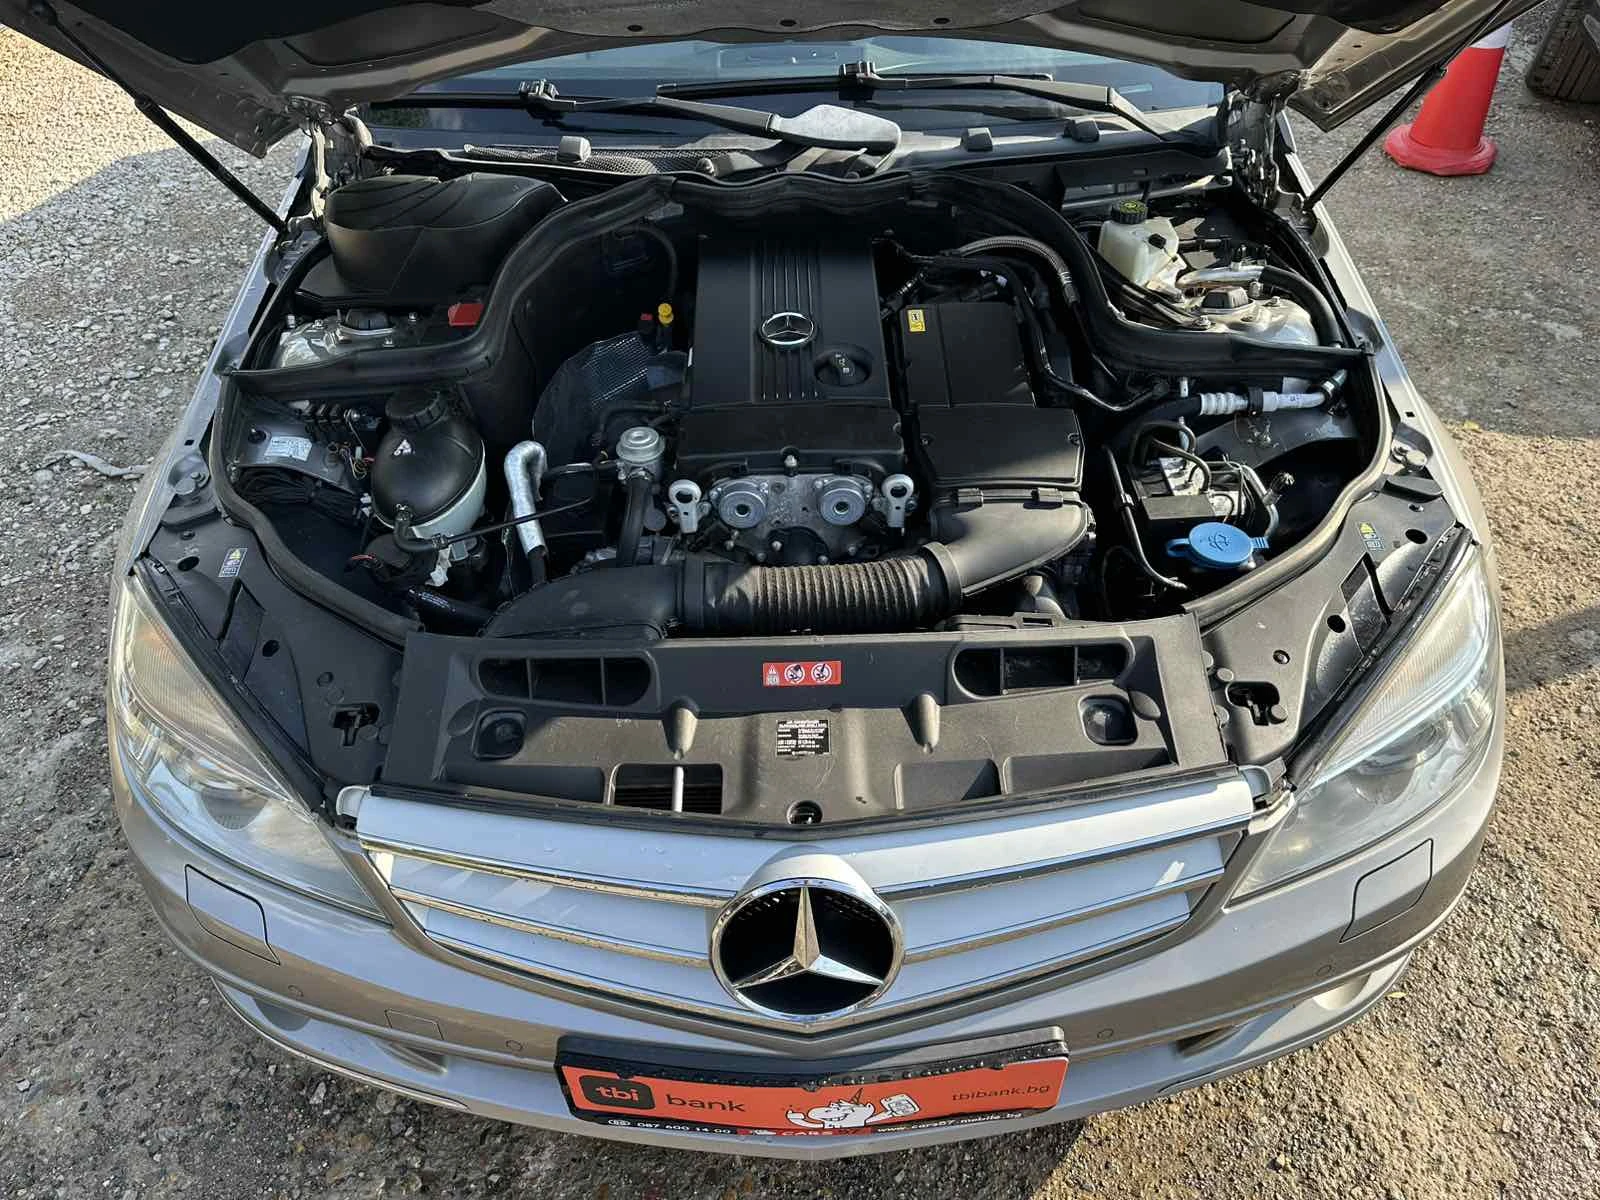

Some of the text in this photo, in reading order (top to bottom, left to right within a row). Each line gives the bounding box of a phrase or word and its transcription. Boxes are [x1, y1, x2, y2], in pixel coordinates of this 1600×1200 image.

[595, 1086, 746, 1112] tbi bank
[952, 1085, 1051, 1101] tbibank.bg
